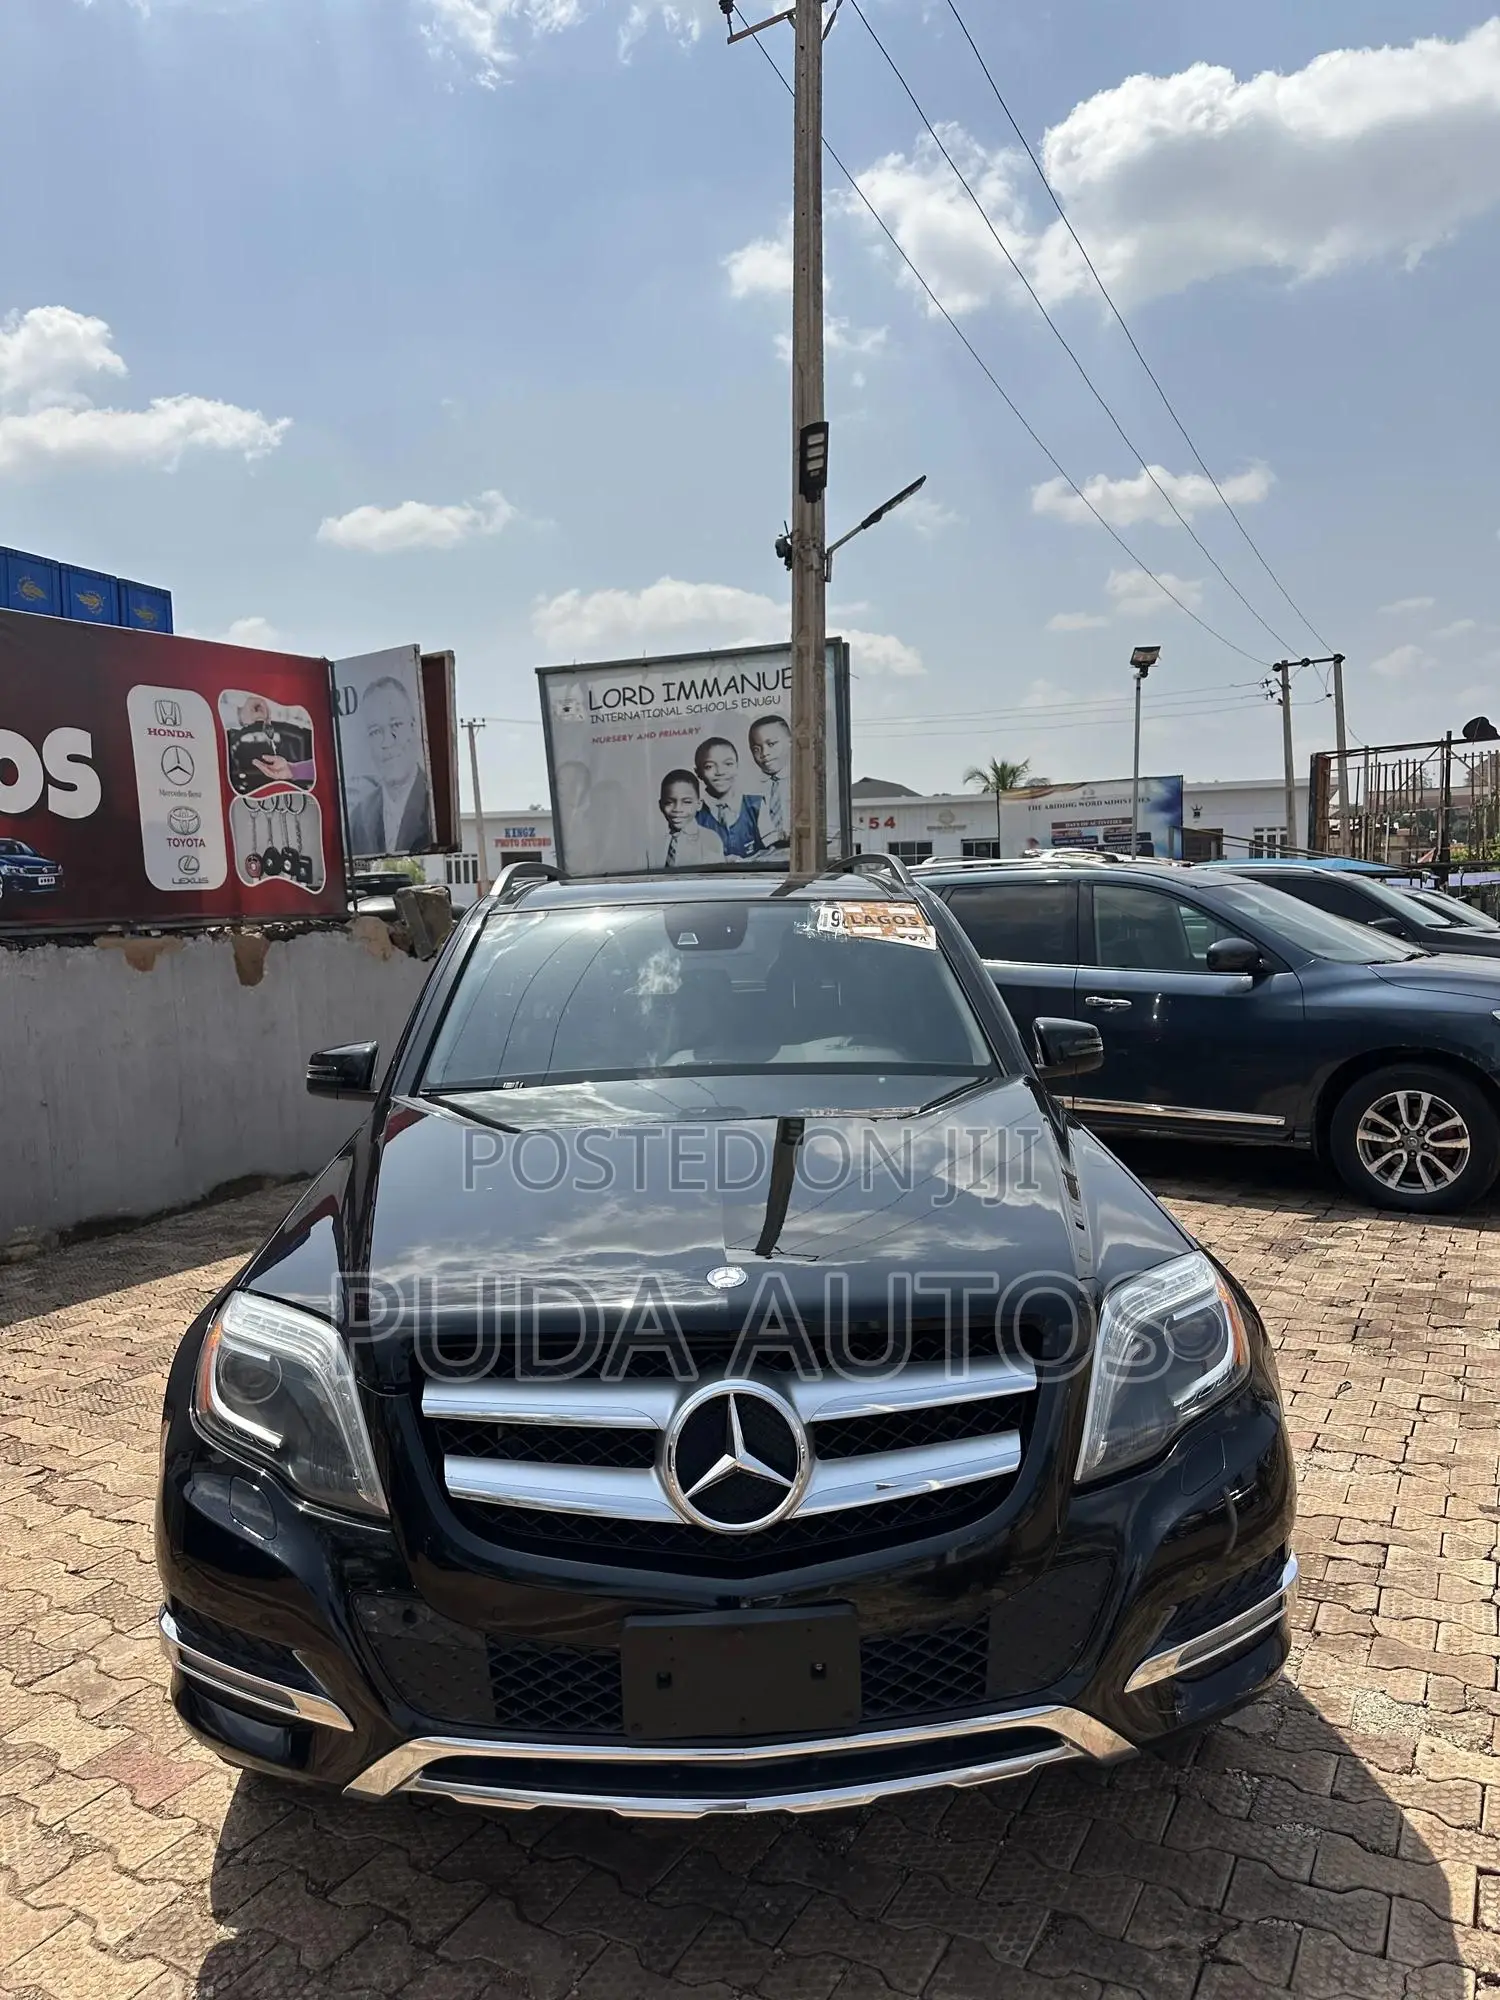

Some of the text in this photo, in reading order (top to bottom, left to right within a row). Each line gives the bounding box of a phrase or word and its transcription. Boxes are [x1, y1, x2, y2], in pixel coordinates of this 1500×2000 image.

[588, 667, 793, 711] LORD IMMANUE
[590, 695, 781, 724] INTERNATIONAL SCHOOLS ENUGU
[147, 728, 195, 739] HONDA
[592, 727, 702, 745] NURSERY AND PRIMARY
[159, 788, 202, 799] Mercedes-Benz
[1079, 800, 1103, 808] WORD
[1104, 797, 1151, 807] MINISTIES
[166, 837, 206, 848] TOYOTA
[172, 877, 209, 885] LEXUS
[850, 915, 920, 926] LAGOS
